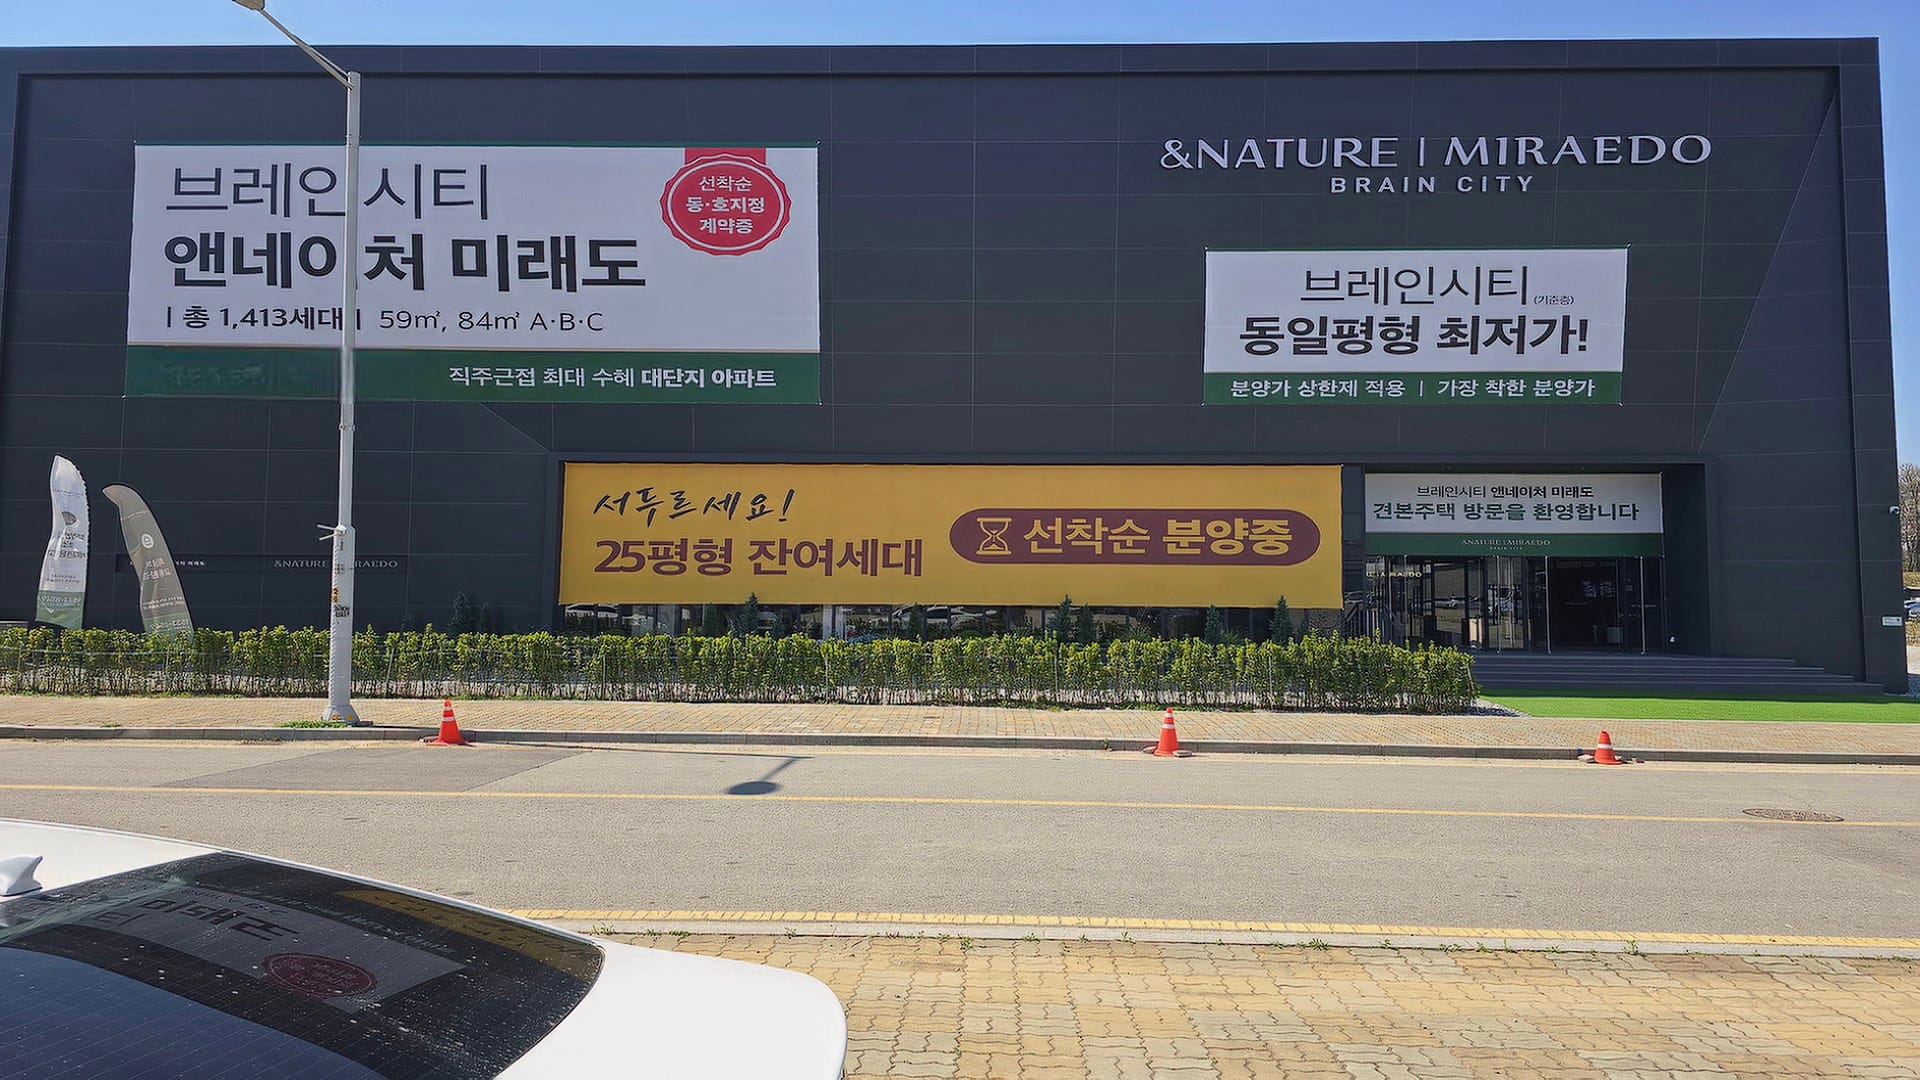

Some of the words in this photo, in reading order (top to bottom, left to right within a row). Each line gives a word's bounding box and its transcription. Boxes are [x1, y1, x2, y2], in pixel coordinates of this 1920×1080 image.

[1161, 138, 1398, 168] &NATURE
[1445, 135, 1711, 165] MIRAEDO
[166, 163, 487, 220] 브레인시티
[698, 175, 753, 192] 선착순
[1330, 176, 1435, 193] BRAIN
[1457, 175, 1533, 192] CITY
[685, 196, 765, 214] 동·호지정
[452, 235, 645, 292] 미래도
[1301, 266, 1527, 305] 브레인시티
[182, 305, 210, 329] 총
[220, 307, 342, 330] 1,413세대
[529, 312, 603, 332] A·B·C
[1240, 316, 1420, 355] 동일평형
[1437, 315, 1588, 354] 최저가!
[449, 366, 536, 387] 직주근접
[543, 367, 585, 387] 최대
[591, 367, 634, 388] 수혜
[641, 368, 705, 388] 대단지
[711, 368, 777, 389] 아파트
[1230, 379, 1292, 398] 분양가
[1297, 379, 1358, 398] 상한제
[1365, 379, 1406, 398] 적용
[1437, 379, 1480, 398] 가장
[1485, 379, 1527, 397] 착한
[1532, 378, 1596, 397] 분양가
[593, 487, 794, 527] 서두르세요!
[1416, 485, 1486, 499] 브레인시티
[1490, 485, 1547, 499] 앤네이처
[1551, 485, 1594, 499] 미래도
[1373, 502, 1455, 521] 견본주택
[1463, 502, 1527, 521] 방문을
[1533, 502, 1640, 521] 환영합니다
[1024, 518, 1150, 554] 선착순
[1163, 518, 1292, 555] 분양중
[595, 538, 732, 576] 25평형
[748, 539, 922, 576] 잔여세대
